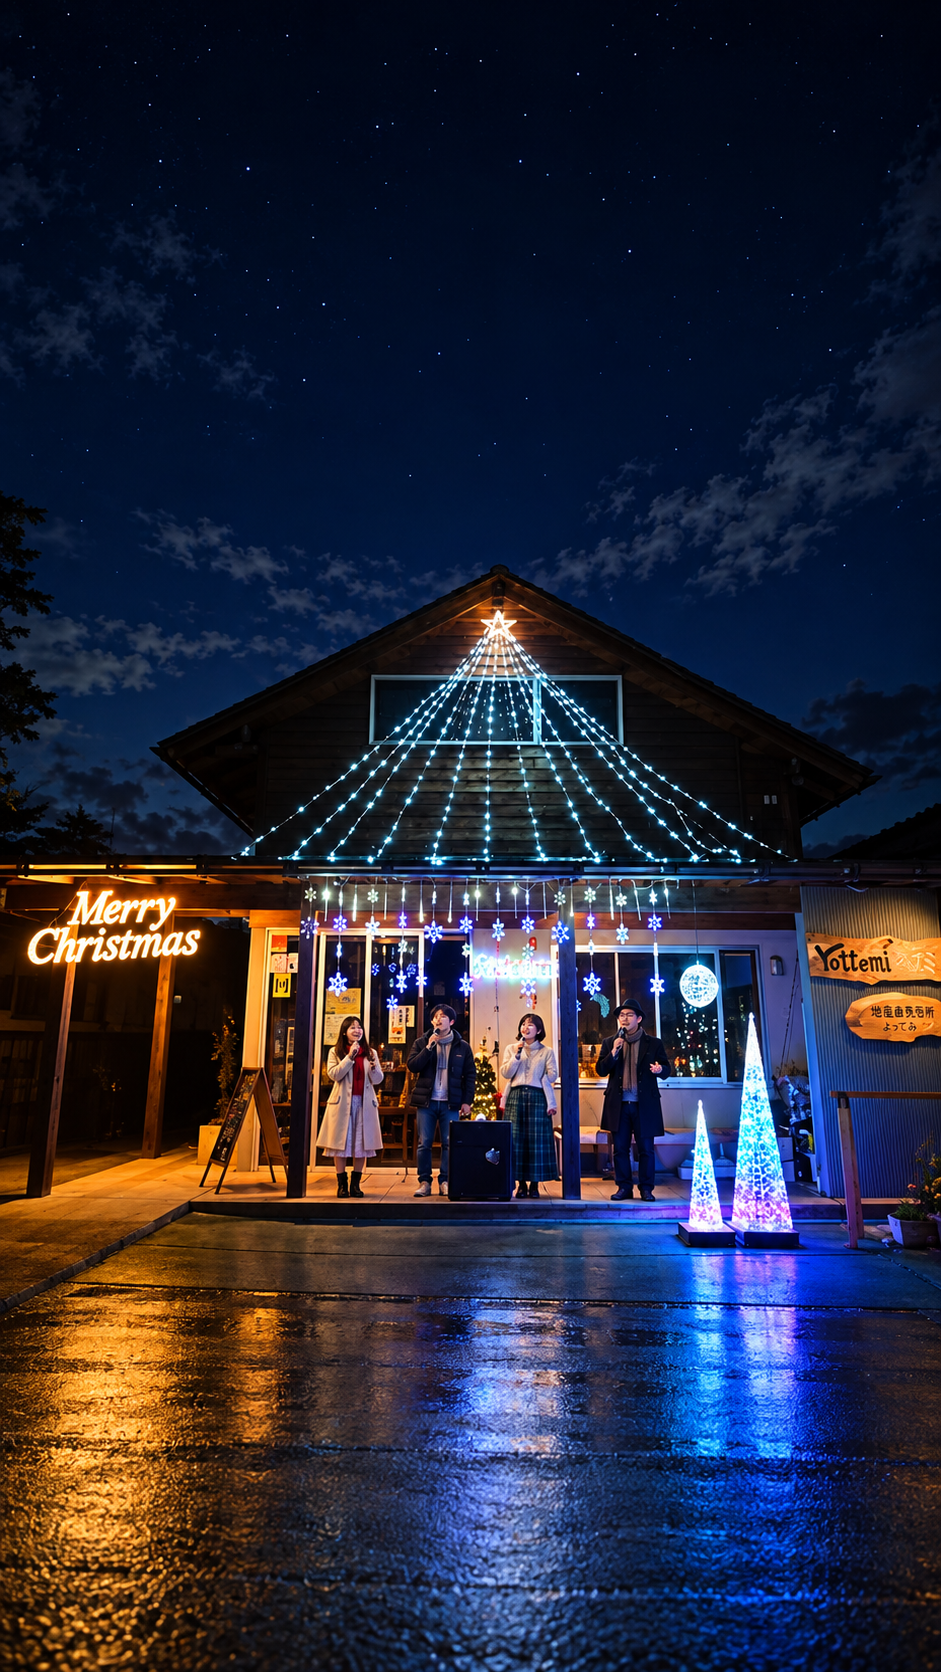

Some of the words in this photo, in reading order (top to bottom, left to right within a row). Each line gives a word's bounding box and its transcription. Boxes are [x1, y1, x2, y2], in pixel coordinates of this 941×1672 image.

[67, 890, 177, 931] Merry
[27, 926, 202, 965] Christmas
[814, 943, 892, 973] Yottemi
[883, 1022, 917, 1032] よってみ
